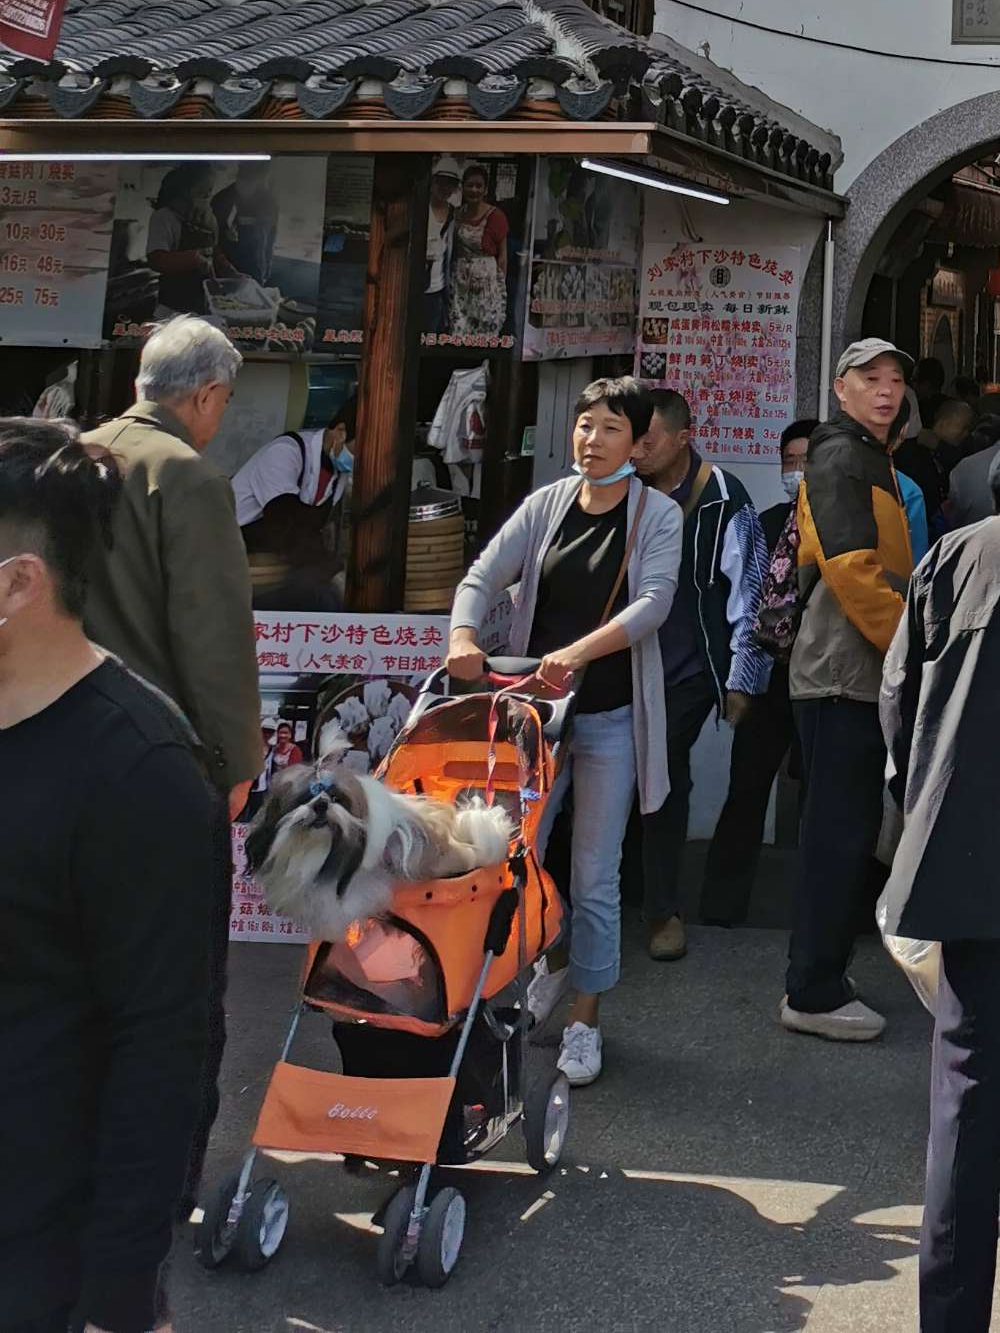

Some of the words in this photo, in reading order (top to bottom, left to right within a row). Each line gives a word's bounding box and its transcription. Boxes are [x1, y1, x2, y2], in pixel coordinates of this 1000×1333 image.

[646, 248, 795, 287] 刘家村下沙特色烧卖
